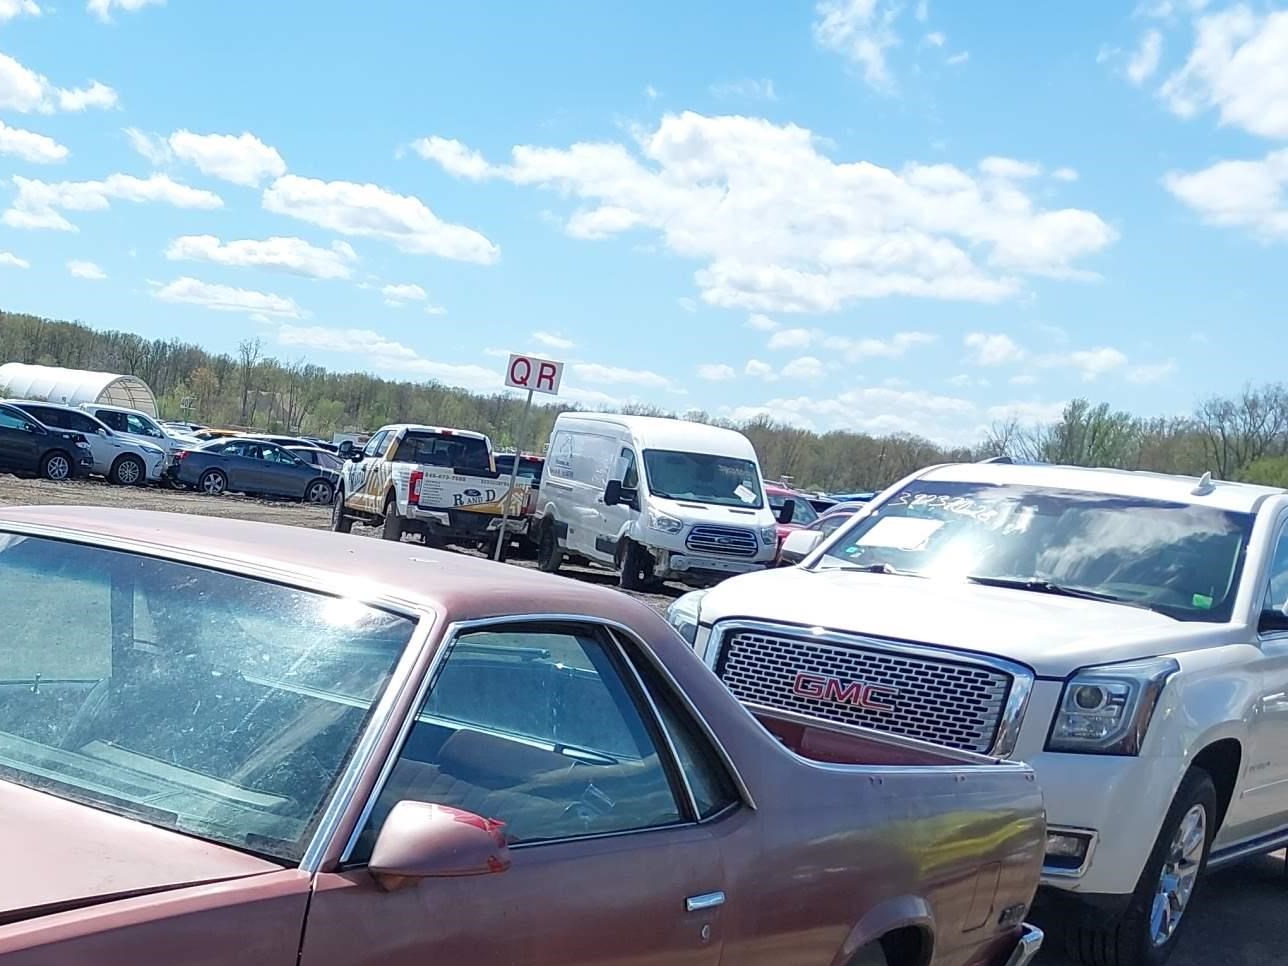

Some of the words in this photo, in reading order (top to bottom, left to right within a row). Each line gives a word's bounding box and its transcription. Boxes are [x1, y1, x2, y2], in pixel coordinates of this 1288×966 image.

[510, 357, 557, 391] QR
[453, 493, 465, 506] R
[467, 495, 483, 504] AND
[486, 489, 496, 502] D
[793, 672, 899, 711] GMC
